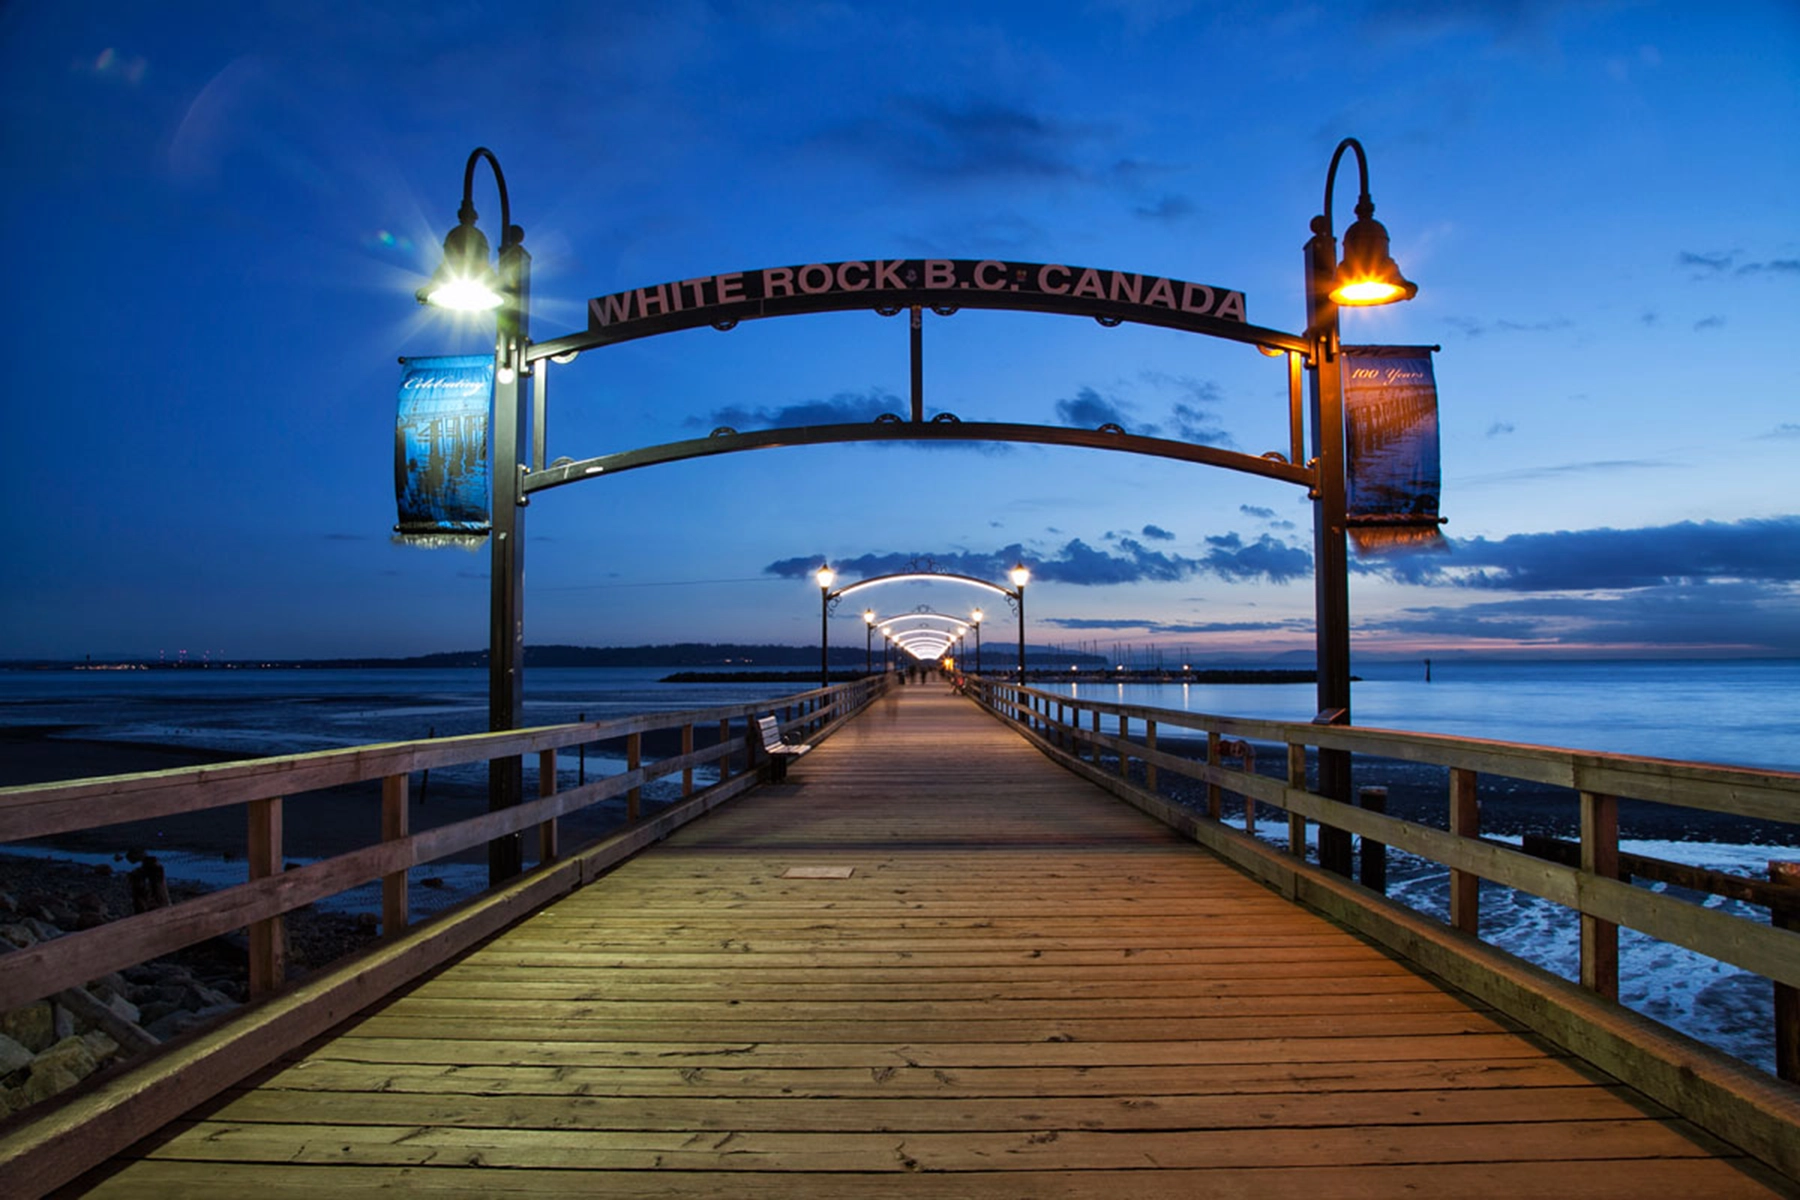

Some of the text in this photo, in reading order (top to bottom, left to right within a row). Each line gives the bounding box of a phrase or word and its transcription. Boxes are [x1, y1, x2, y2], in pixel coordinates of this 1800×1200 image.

[589, 260, 1246, 327] WHITE ROCK B.C. CANADA
[404, 376, 484, 397] Celebrating
[1351, 367, 1423, 386] 100 Years
